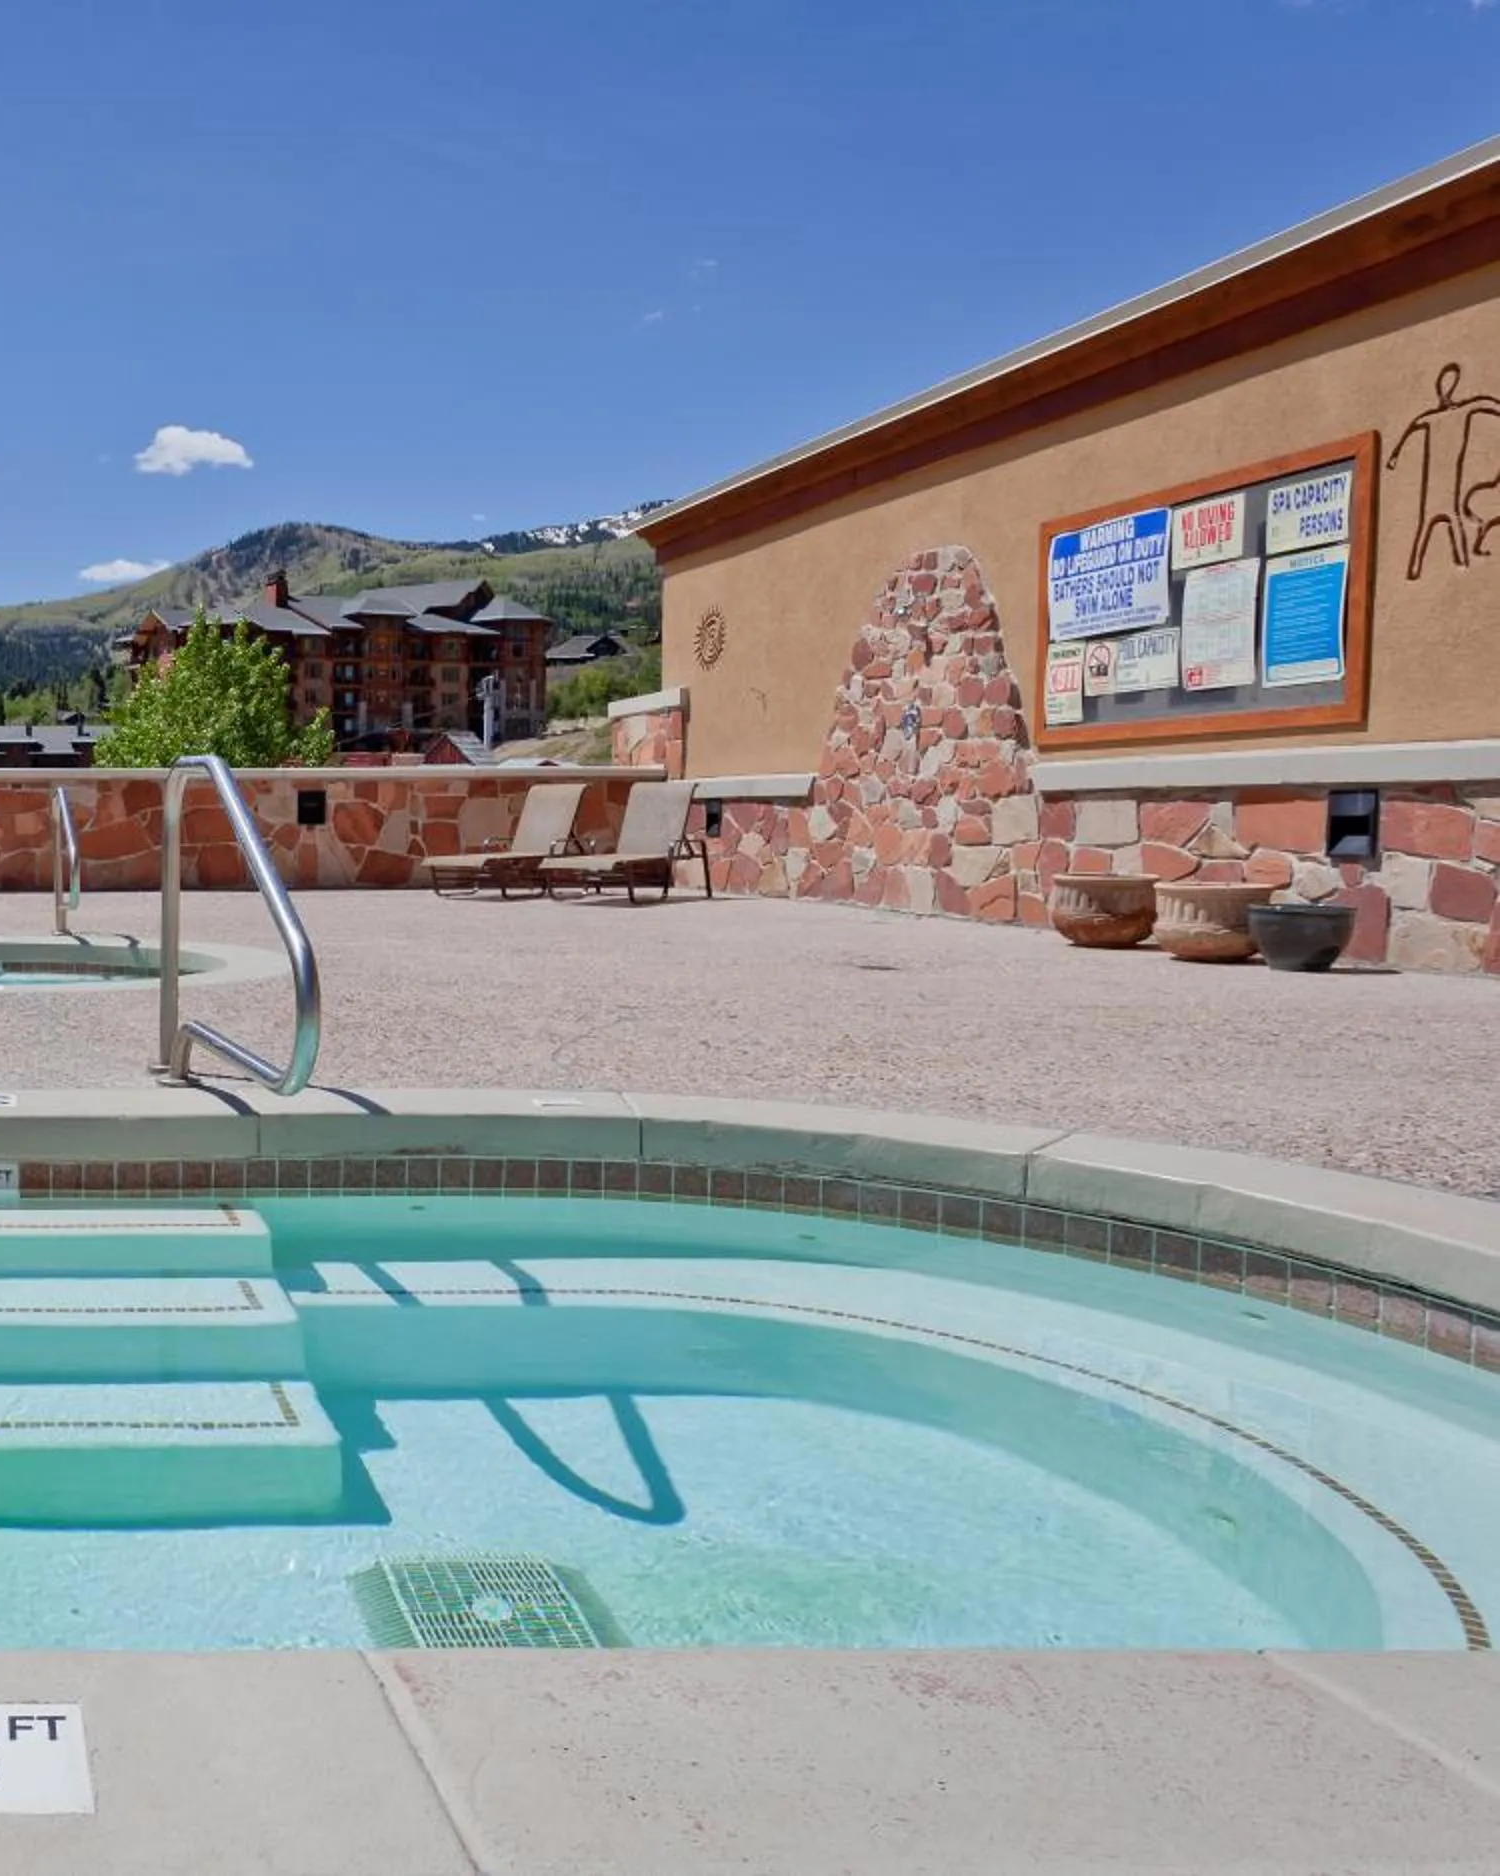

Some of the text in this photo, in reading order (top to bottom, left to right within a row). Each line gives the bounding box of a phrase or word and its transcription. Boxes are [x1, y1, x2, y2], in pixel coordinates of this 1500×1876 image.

[1273, 476, 1347, 514] SPA CAPACITY
[1181, 501, 1234, 531] NO DIVING
[1300, 508, 1343, 537] PERSONS
[1080, 519, 1134, 552] WARNING
[1184, 521, 1233, 549] ALLOWED
[1053, 535, 1164, 579] NO LIFEGUARD ON DUTY
[1054, 560, 1160, 602] BATHERS SHOULD NOT
[1075, 595, 1099, 618] SWIM
[1102, 587, 1133, 612] ALONE
[8, 1715, 66, 1741] FT
